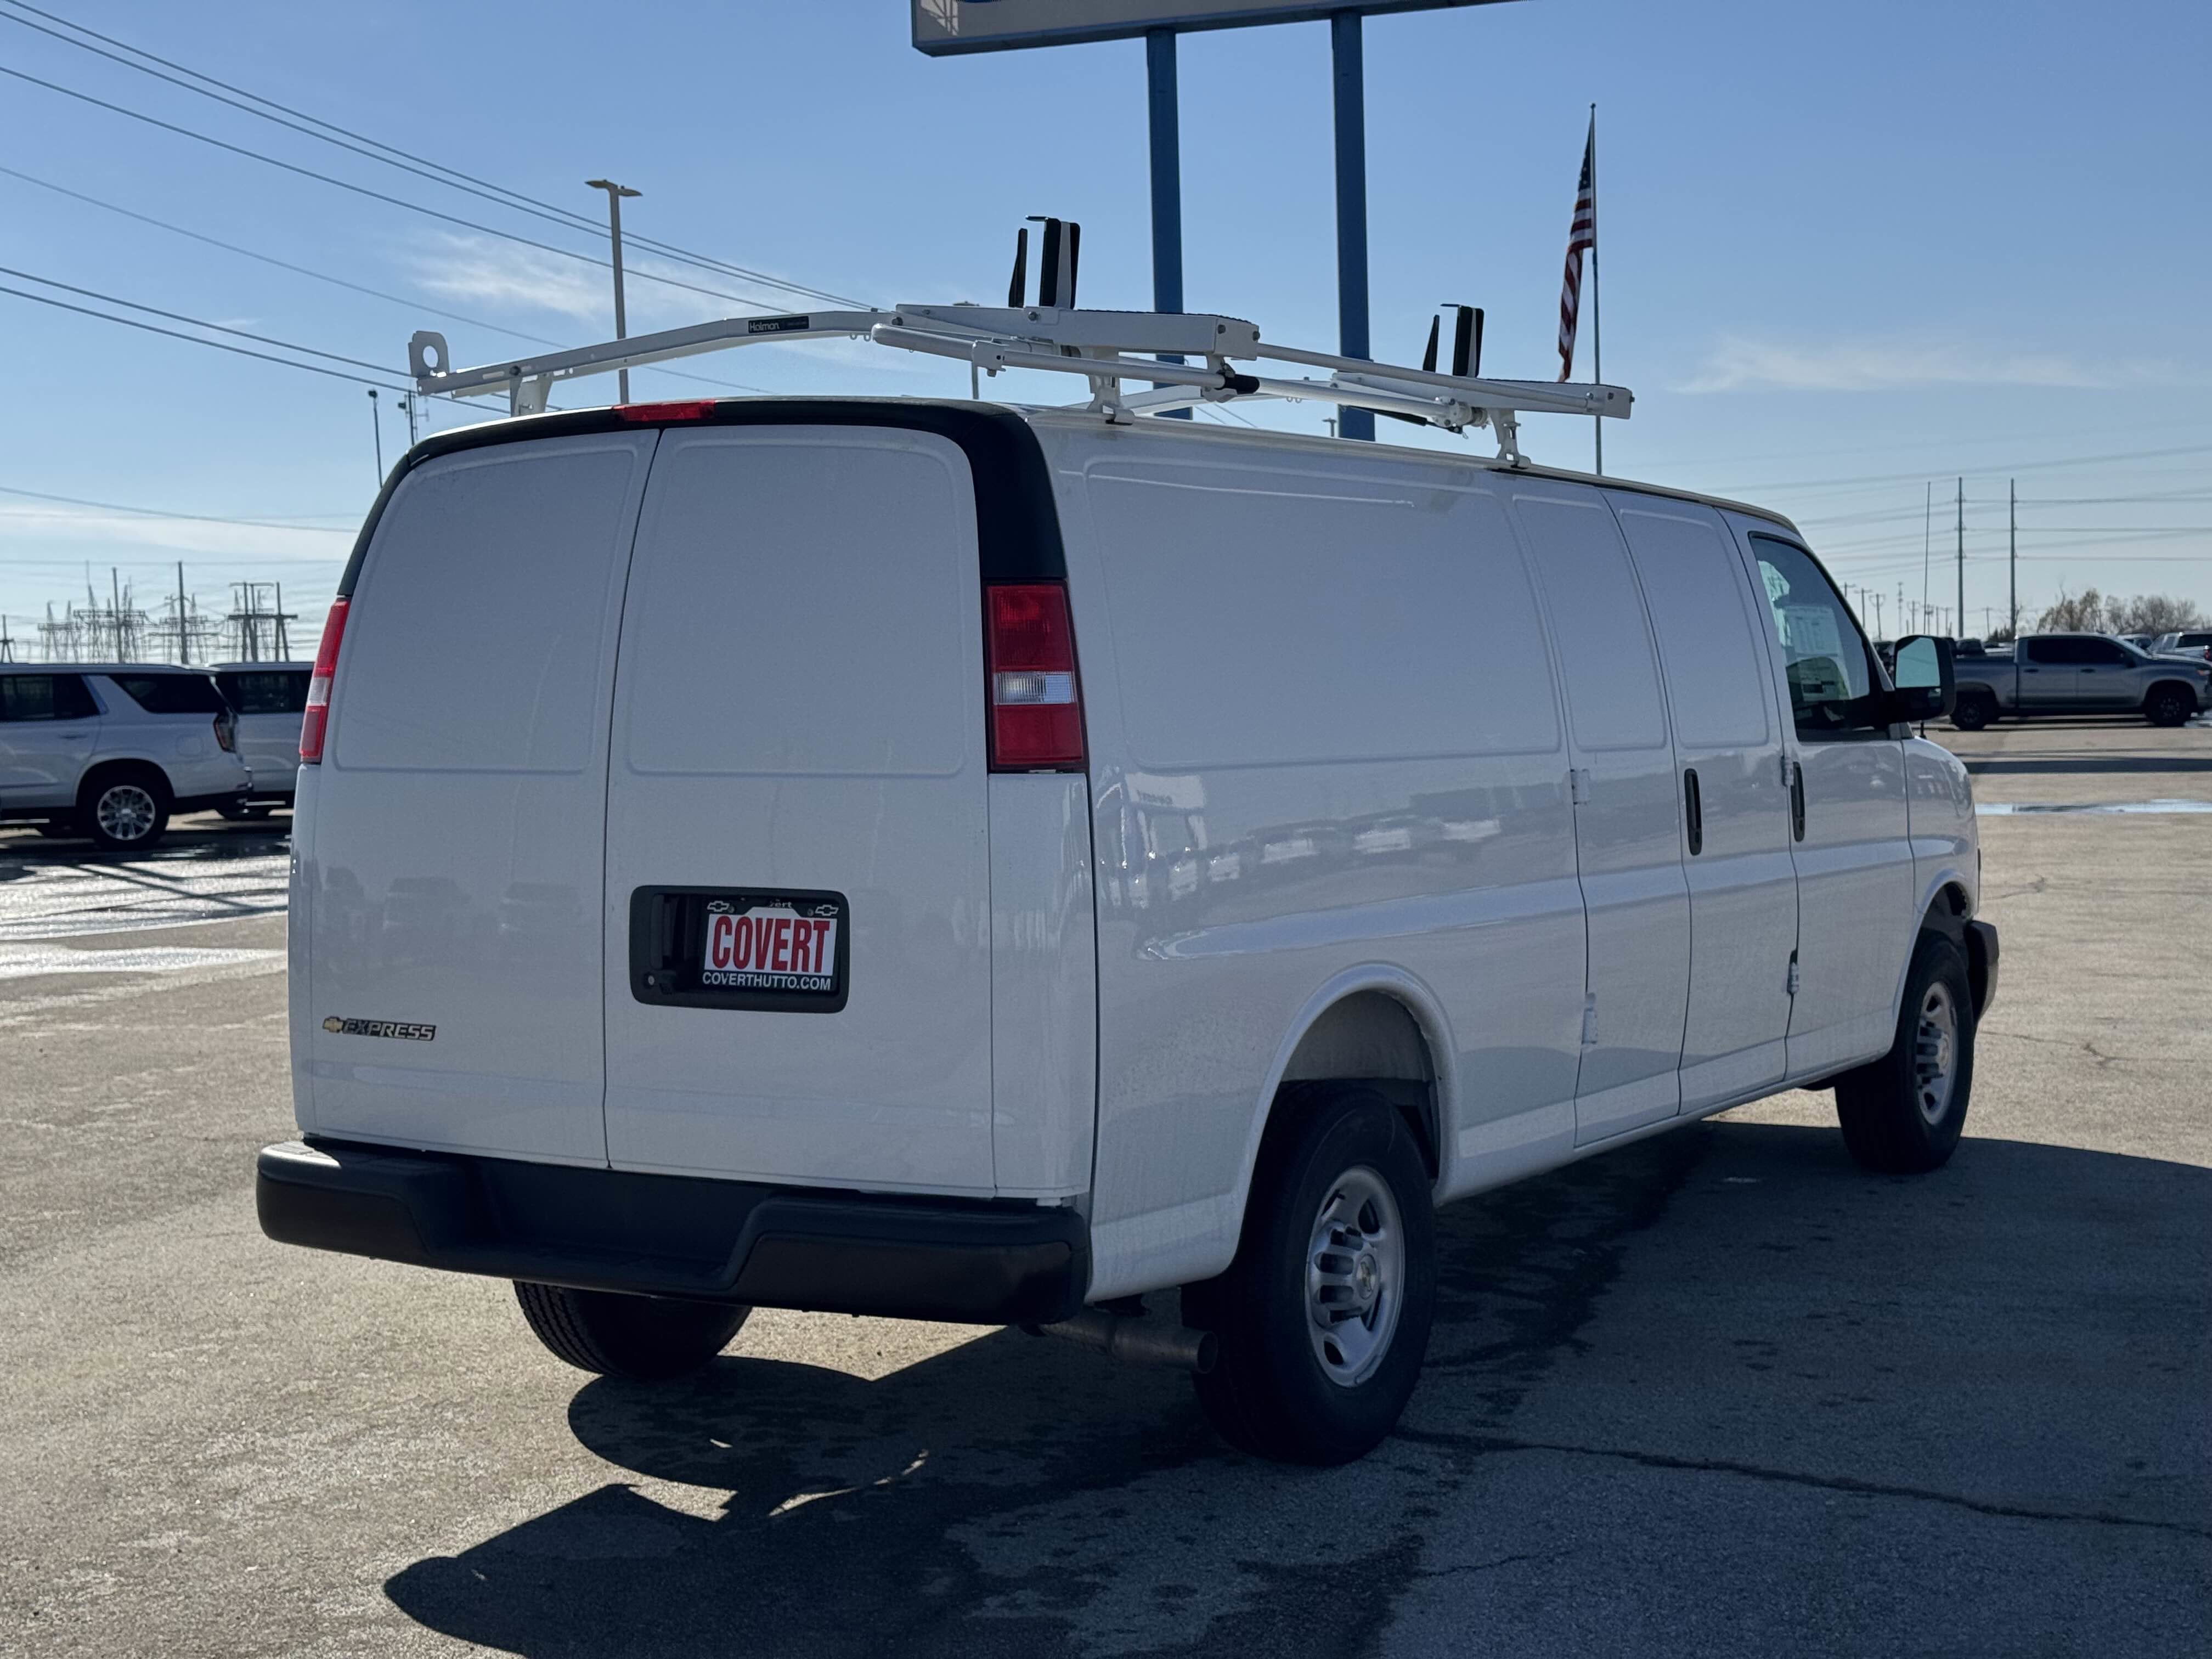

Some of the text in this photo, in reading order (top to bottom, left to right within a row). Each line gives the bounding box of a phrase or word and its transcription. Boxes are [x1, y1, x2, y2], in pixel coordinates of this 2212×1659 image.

[749, 321, 780, 332] Holman
[713, 916, 830, 973] COVERT
[703, 972, 831, 990] COVERTHUTTO.COM
[343, 1019, 435, 1041] EXPRESS
